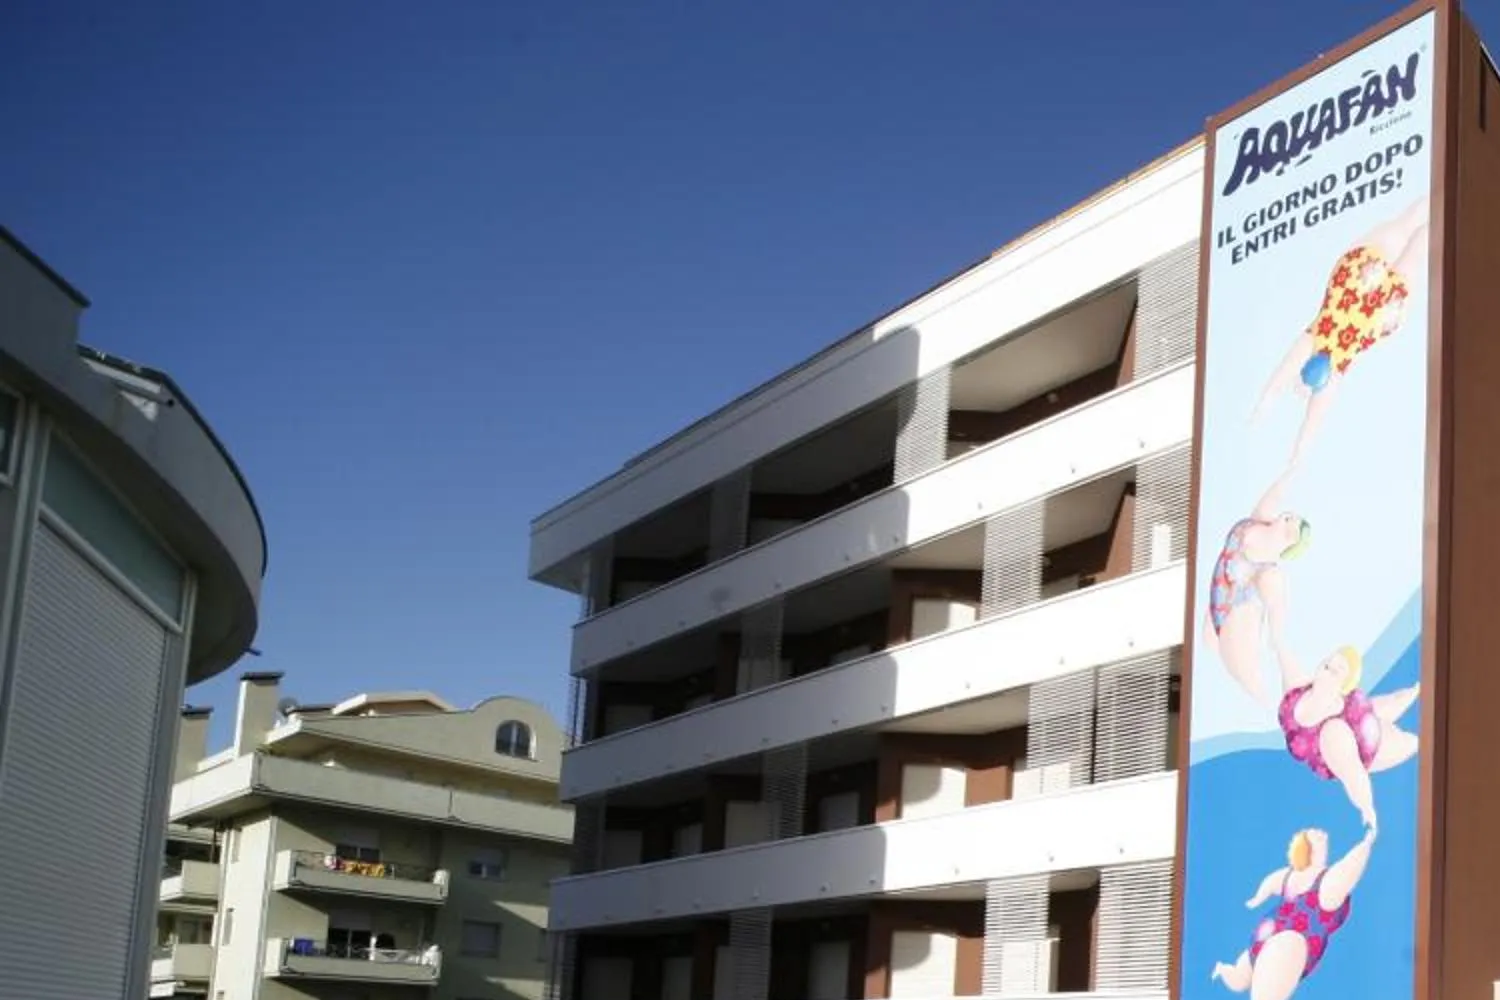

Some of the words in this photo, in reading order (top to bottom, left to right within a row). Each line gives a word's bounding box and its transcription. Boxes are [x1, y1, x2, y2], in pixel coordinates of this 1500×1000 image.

[1217, 226, 1236, 249] IL
[1243, 173, 1338, 234] GIORNO
[1345, 134, 1423, 185] DOPO
[1231, 216, 1297, 265] ENTRI
[1303, 167, 1403, 228] GRATIS!
